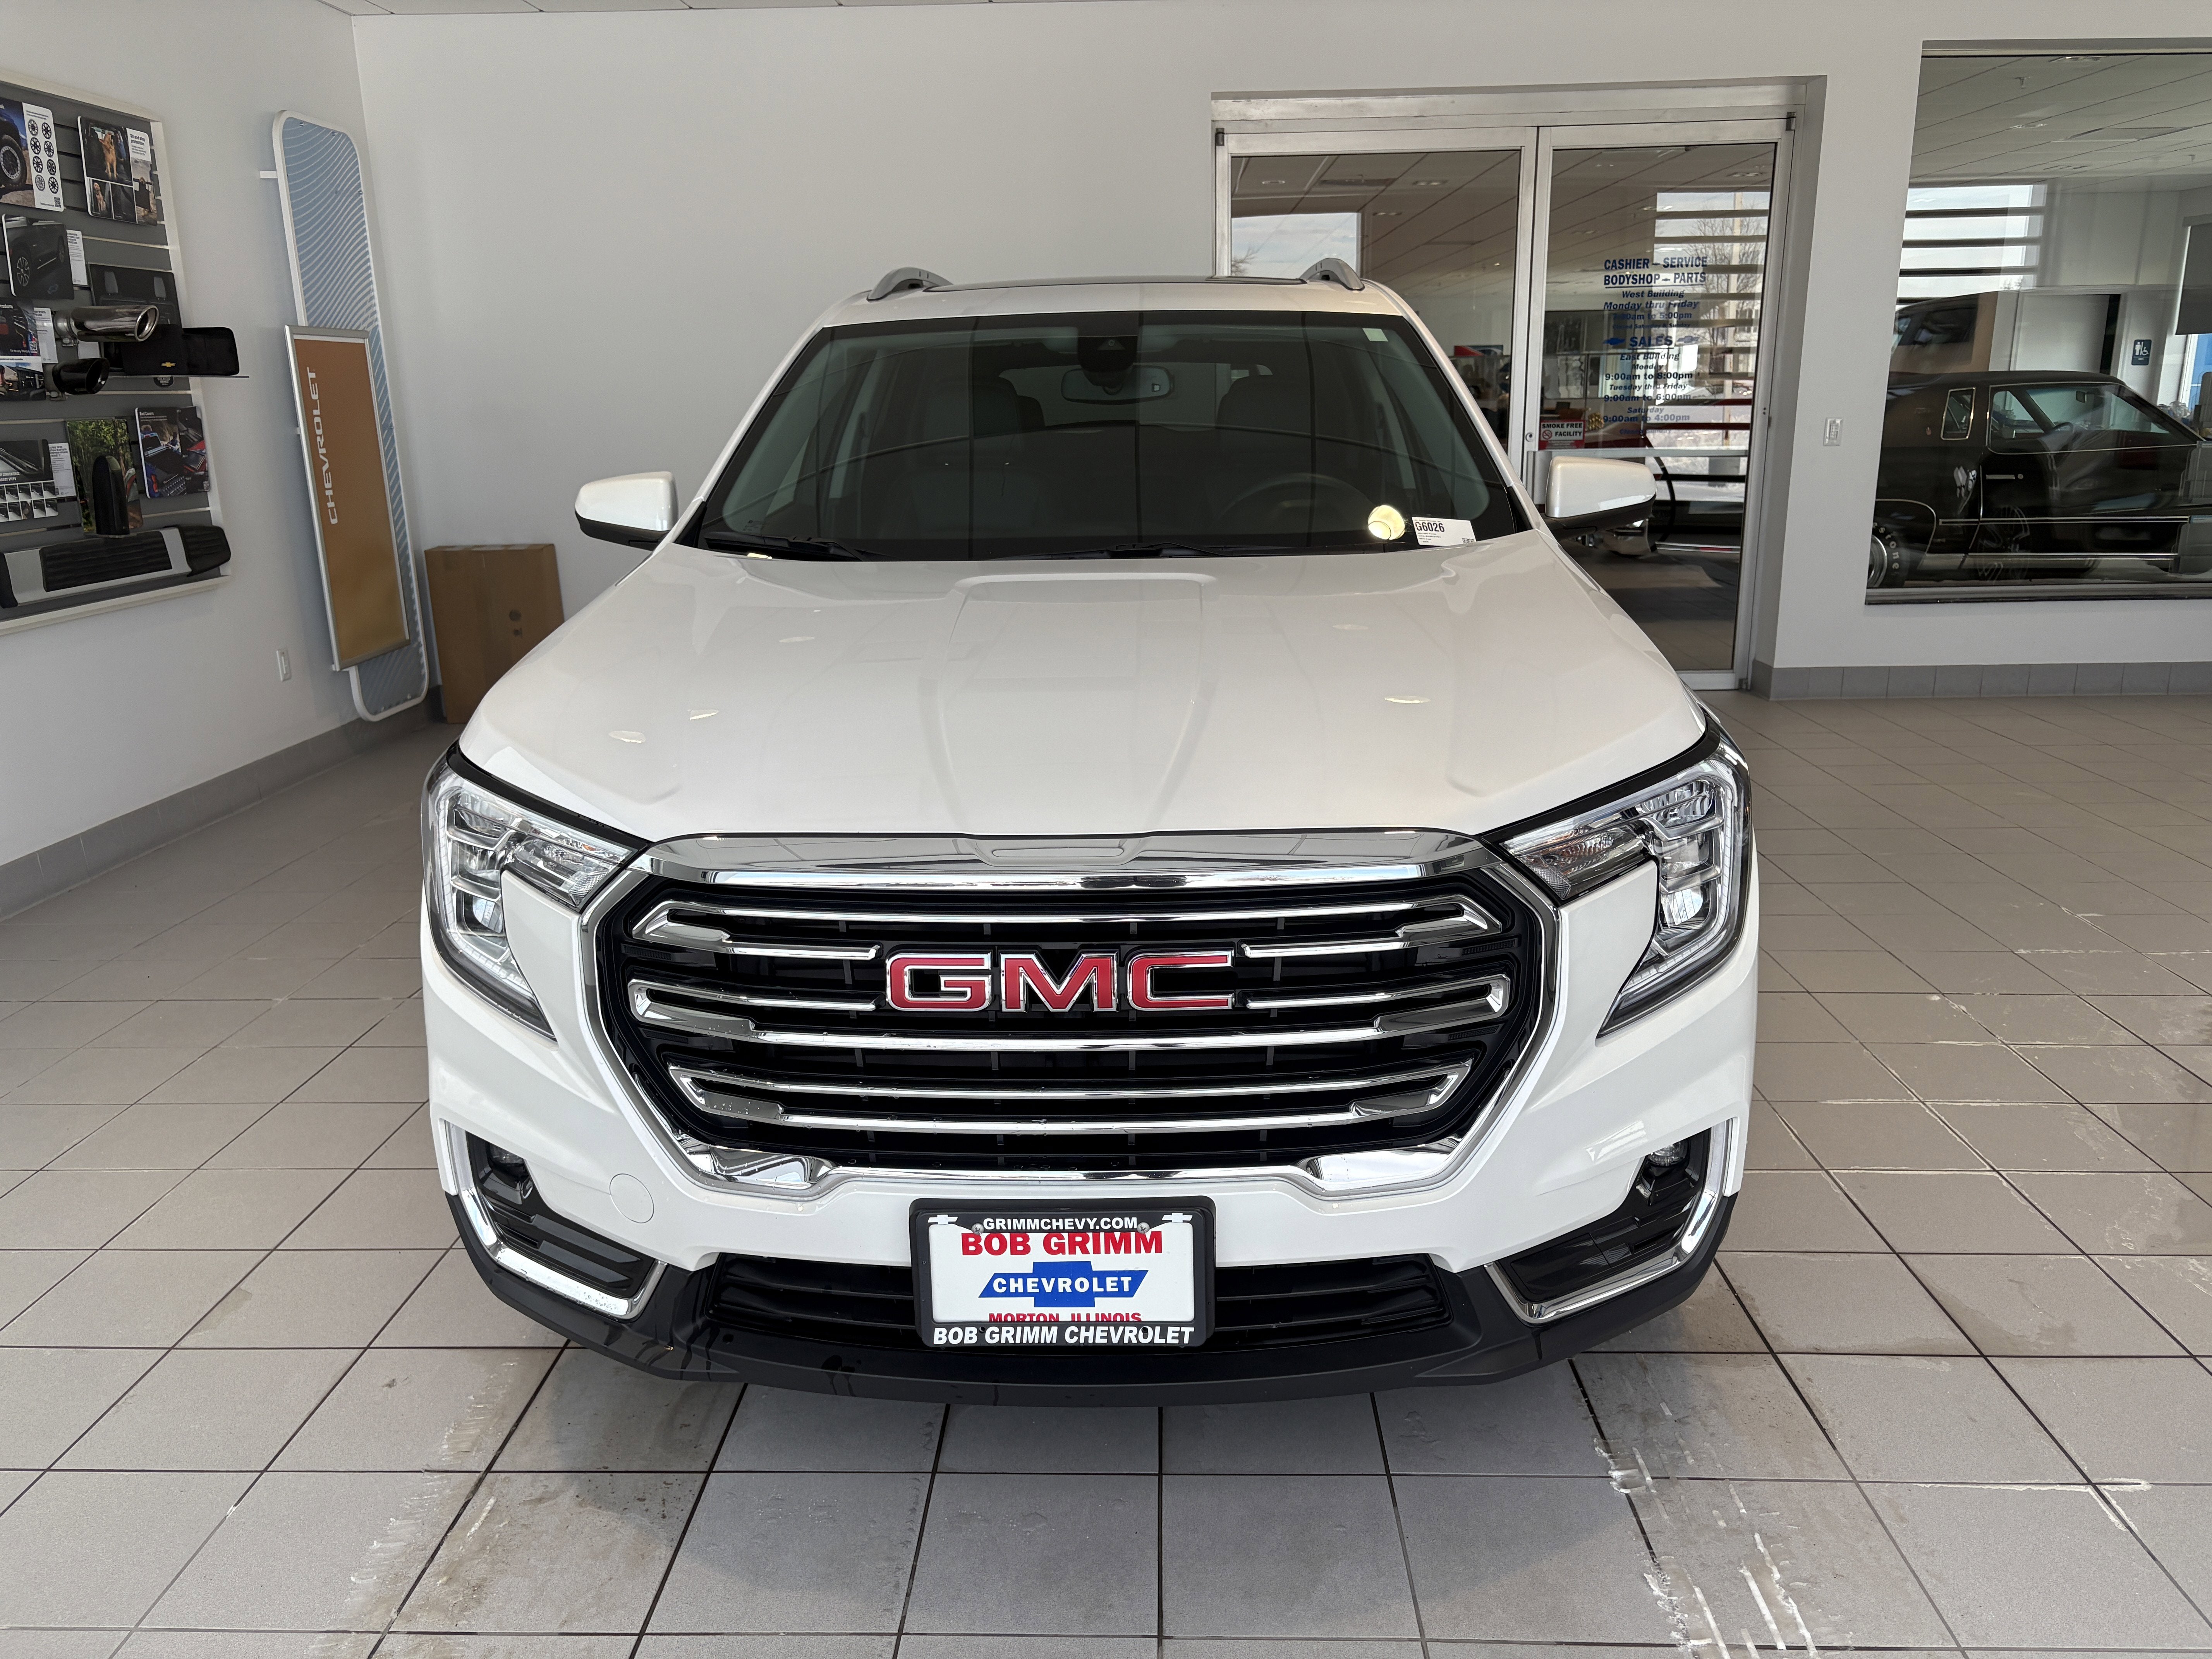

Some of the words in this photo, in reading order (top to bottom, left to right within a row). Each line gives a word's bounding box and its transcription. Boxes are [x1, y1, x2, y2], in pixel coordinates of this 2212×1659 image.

[1604, 258, 1650, 270] CASHIER
[1663, 256, 1707, 268] SERVICE
[1604, 273, 1660, 285] BODYSHOP
[1674, 272, 1706, 283] PARTS
[1647, 290, 1685, 298] Building
[1604, 301, 1642, 310] Monday
[1645, 301, 1665, 309] thru
[1668, 300, 1700, 309] Friday
[1659, 312, 1692, 320] 5:00pm
[1629, 336, 1673, 347] SALES
[1657, 372, 1693, 380] 8:00pm
[307, 367, 338, 524] CHEVROLET
[1415, 522, 1444, 532] G6026
[886, 948, 1235, 1012] GMC
[983, 1217, 1137, 1230] GRIMMCHEVY.COM
[962, 1233, 1031, 1255] BOB
[1043, 1231, 1162, 1255] GRIMM
[993, 1277, 1132, 1293] CHEVROLET
[989, 1313, 1059, 1322] MORTON
[933, 1327, 978, 1345] BOB
[985, 1326, 1058, 1344] GRIMM
[1065, 1326, 1194, 1344] CHEVROLET
